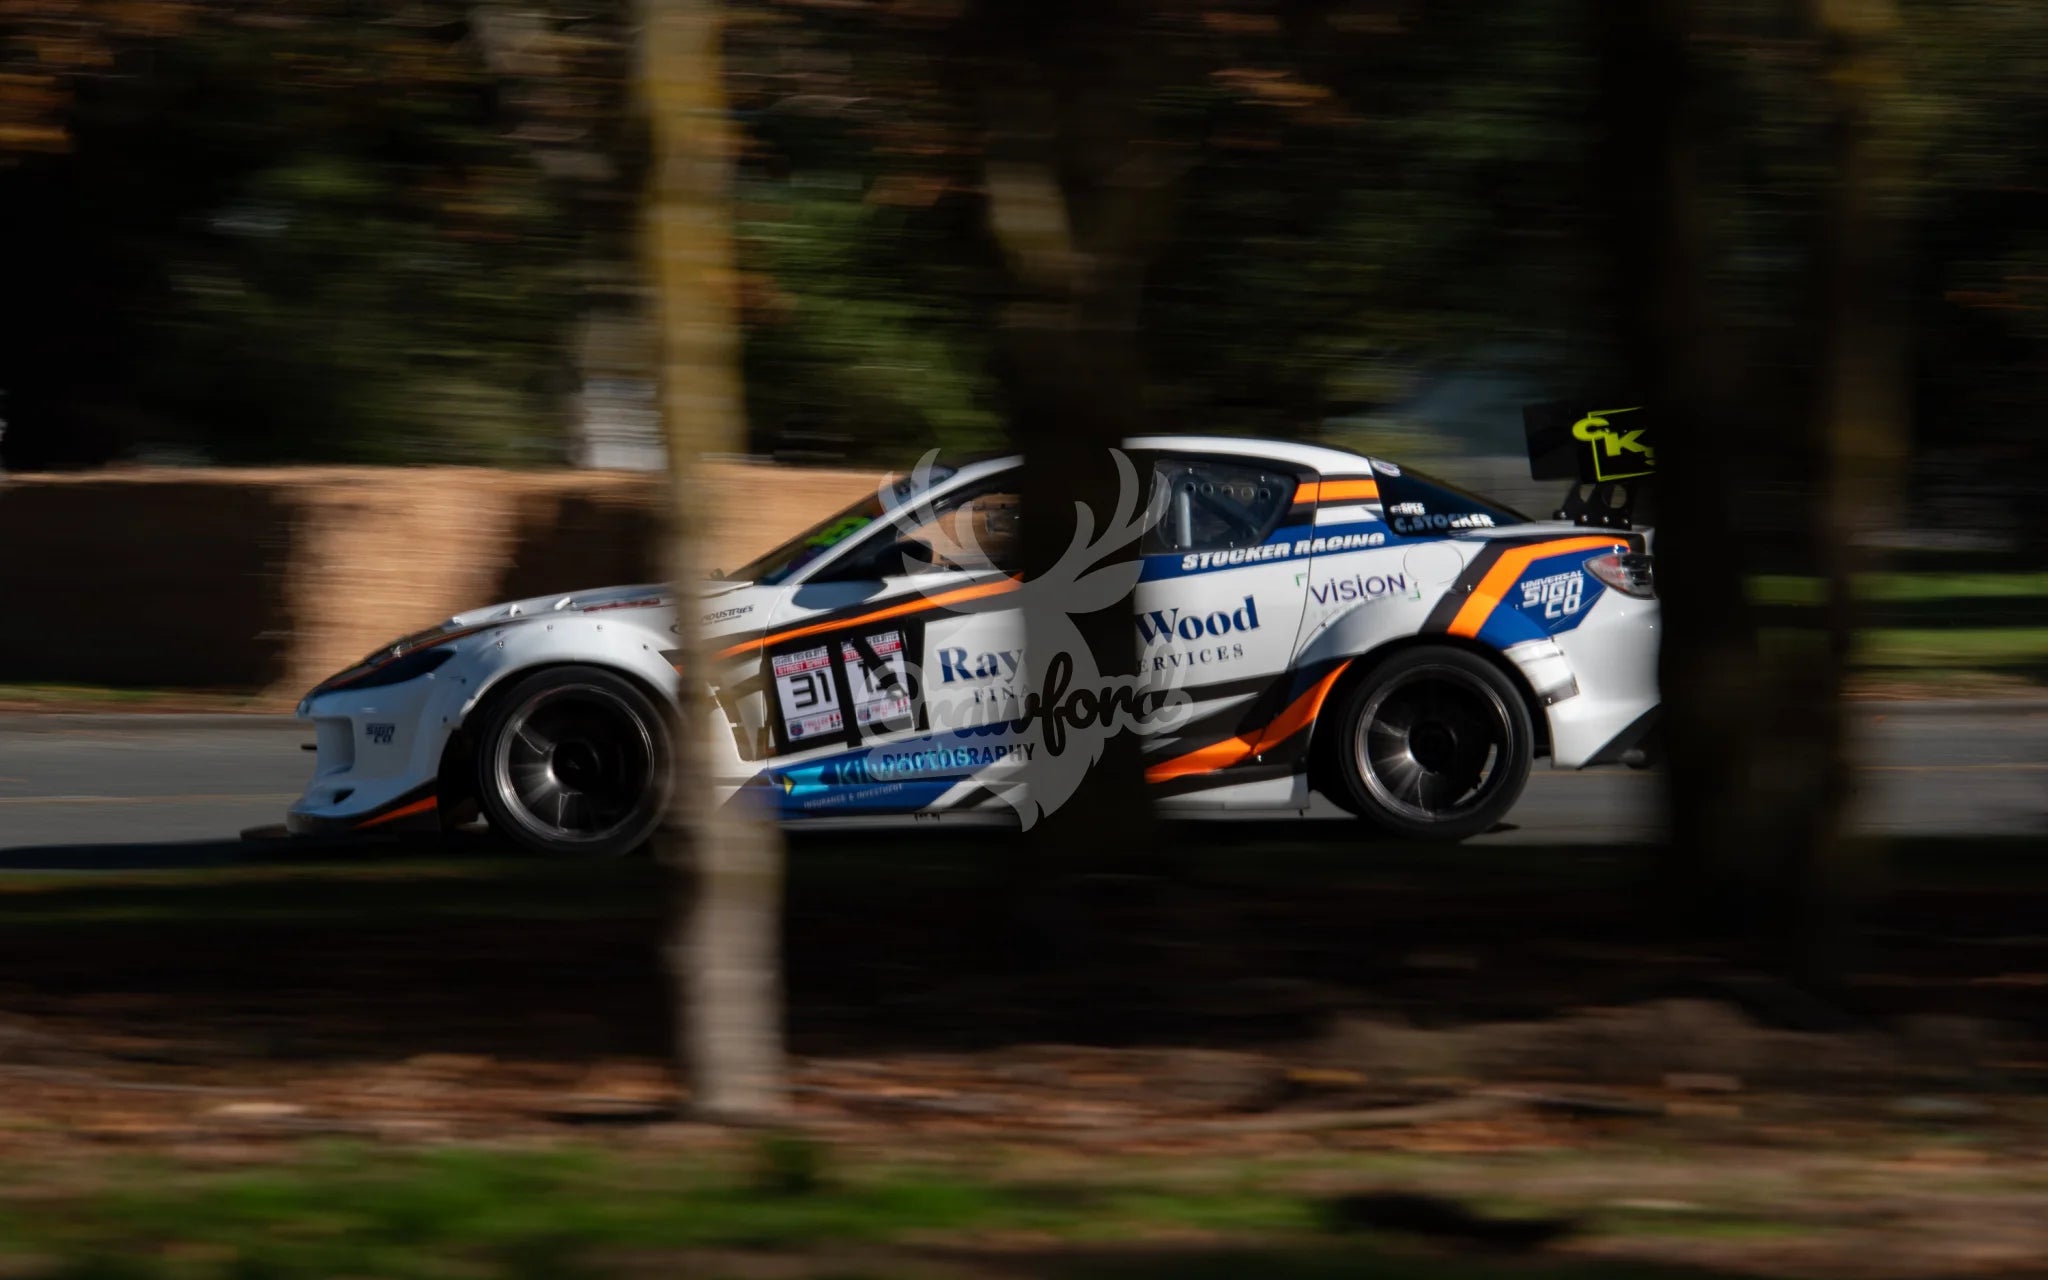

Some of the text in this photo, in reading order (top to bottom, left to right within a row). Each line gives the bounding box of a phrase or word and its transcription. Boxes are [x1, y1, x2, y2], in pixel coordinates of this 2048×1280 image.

[1181, 532, 1386, 571] STOCKER RACING
[1521, 570, 1584, 591] UNIVERSAL
[1545, 594, 1581, 619] CO
[937, 645, 1025, 686] Ray
[1135, 594, 1261, 646] Wood
[1138, 643, 1244, 674] ERVICES
[790, 670, 832, 709] 31
